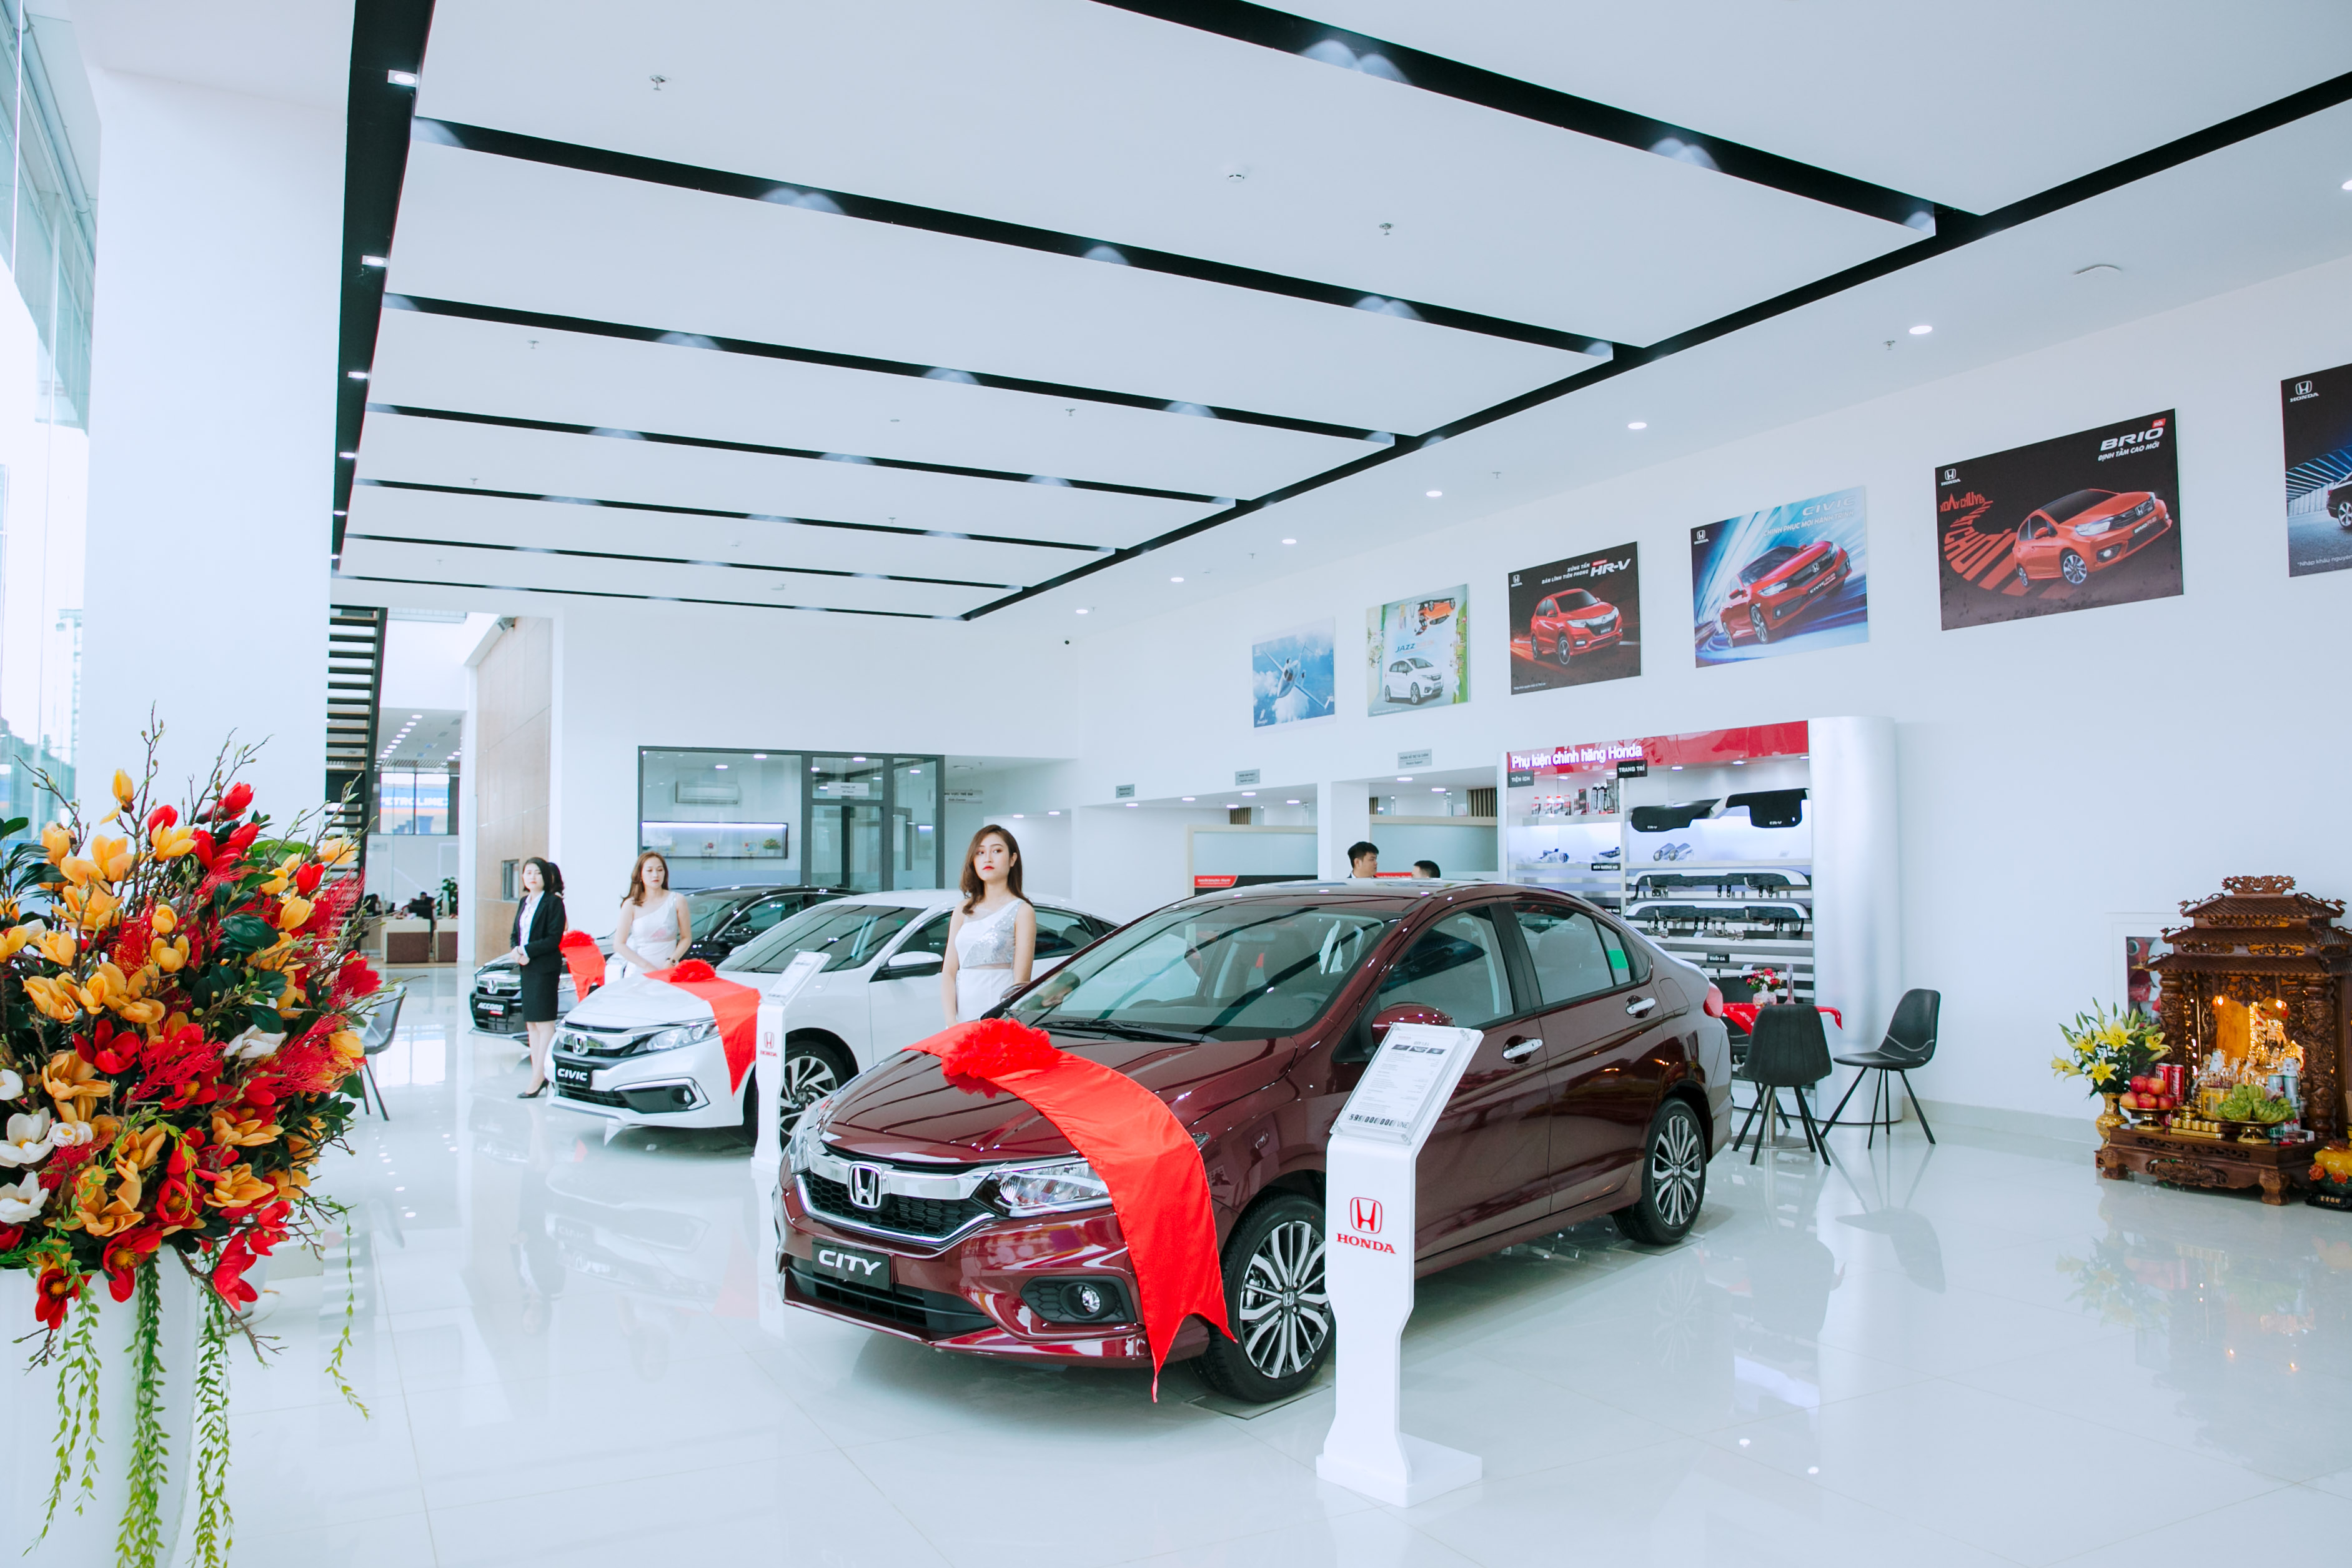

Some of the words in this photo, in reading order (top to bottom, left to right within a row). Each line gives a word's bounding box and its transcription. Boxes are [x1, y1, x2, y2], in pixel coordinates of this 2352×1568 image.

[2290, 392, 2319, 402] HONDA
[2100, 427, 2164, 451] BRIO
[2098, 452, 2115, 462] ĐỊNH
[2130, 445, 2145, 454] CAO
[1802, 496, 1857, 517] CIVIC
[1764, 526, 1782, 537] CHINH
[1782, 522, 1800, 532] PHỤC
[1801, 519, 1814, 529] MỌI
[1590, 558, 1631, 577] HR-V
[1395, 643, 1416, 653] JAZZ
[1512, 755, 1531, 770] Phụ
[1531, 753, 1551, 768] kiện
[1552, 750, 1580, 765] chính
[1580, 748, 1607, 764] hãng
[1608, 743, 1643, 760] Honda
[477, 1002, 504, 1011] ACCORD
[557, 1068, 588, 1081] CIVIC
[1336, 1233, 1396, 1254] HONDA
[818, 1249, 881, 1276] CITY
